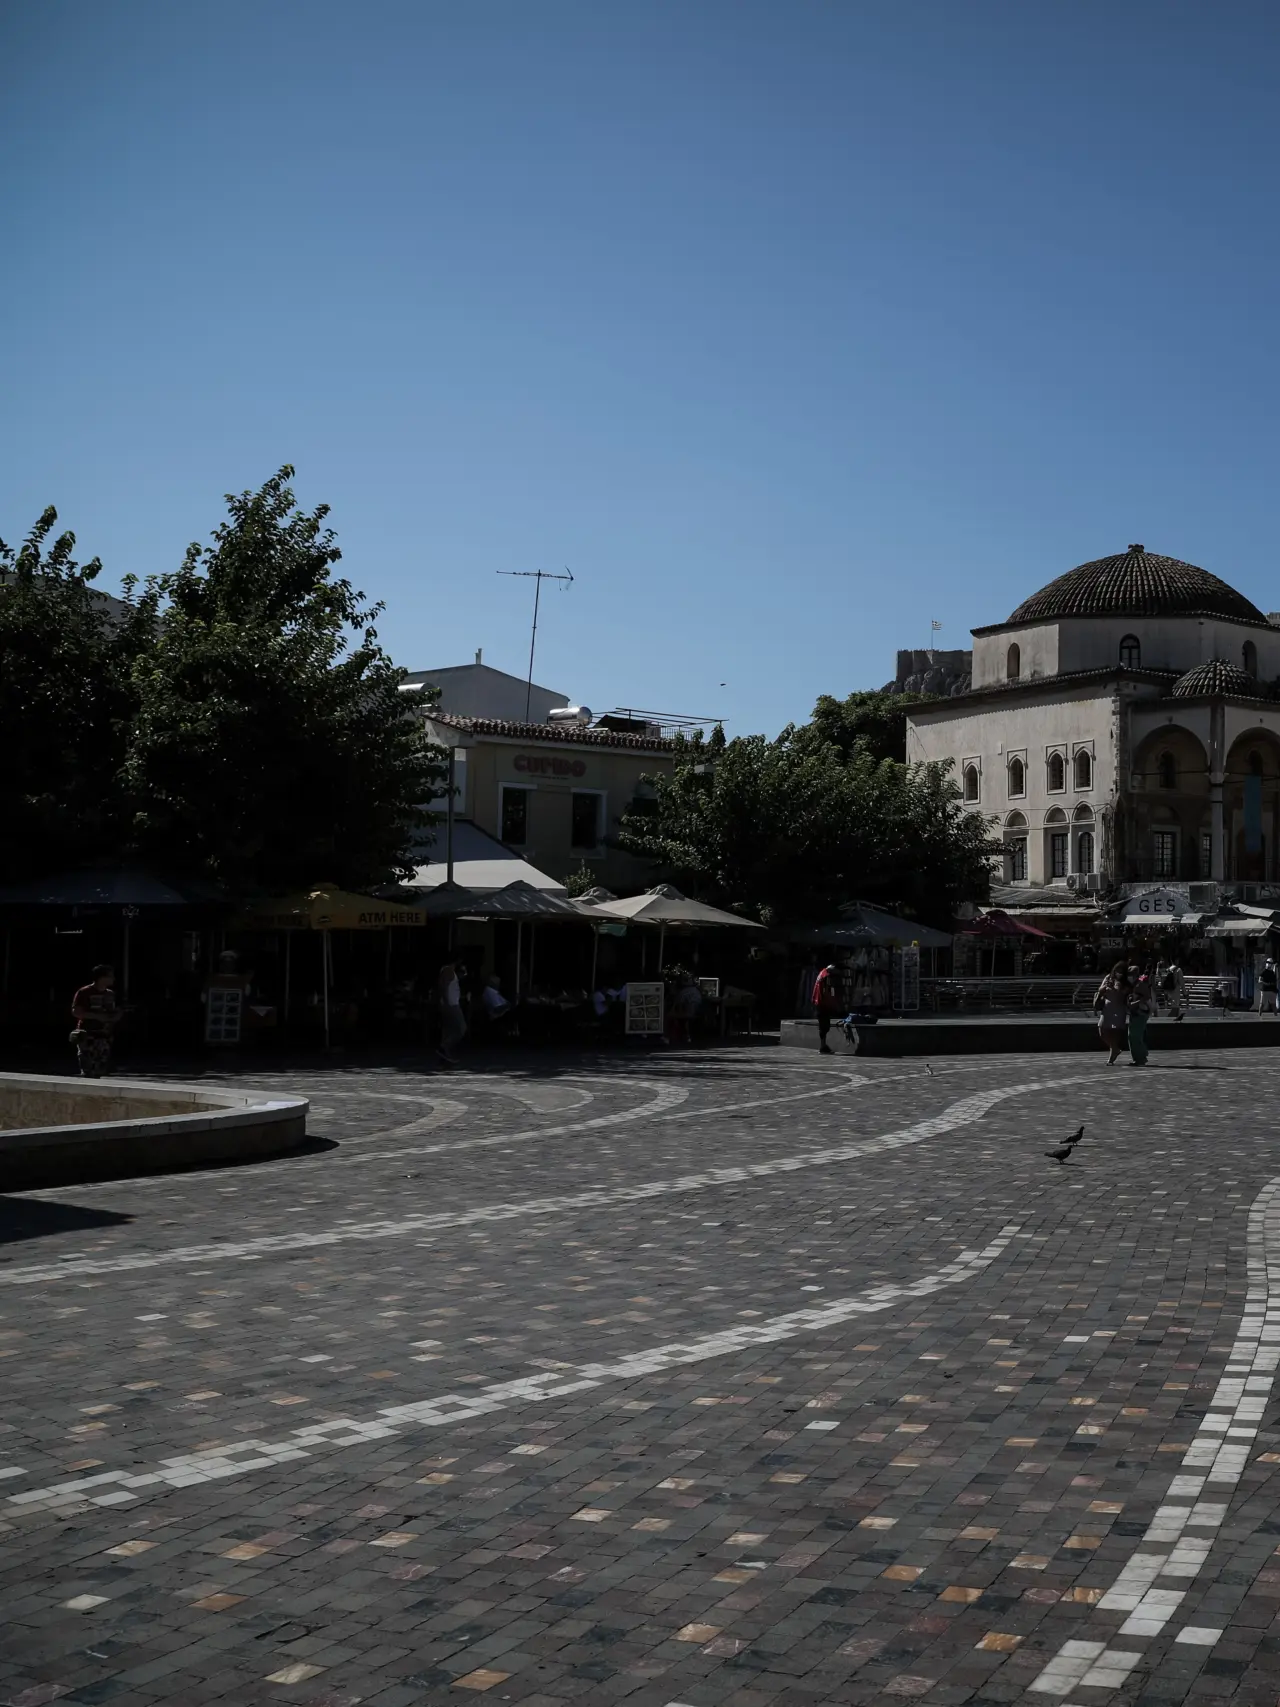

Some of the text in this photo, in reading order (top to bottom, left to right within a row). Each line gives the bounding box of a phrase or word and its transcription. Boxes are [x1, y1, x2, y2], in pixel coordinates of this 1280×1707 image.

[1139, 899, 1176, 912] GES
[359, 911, 421, 923] ATM HERE
